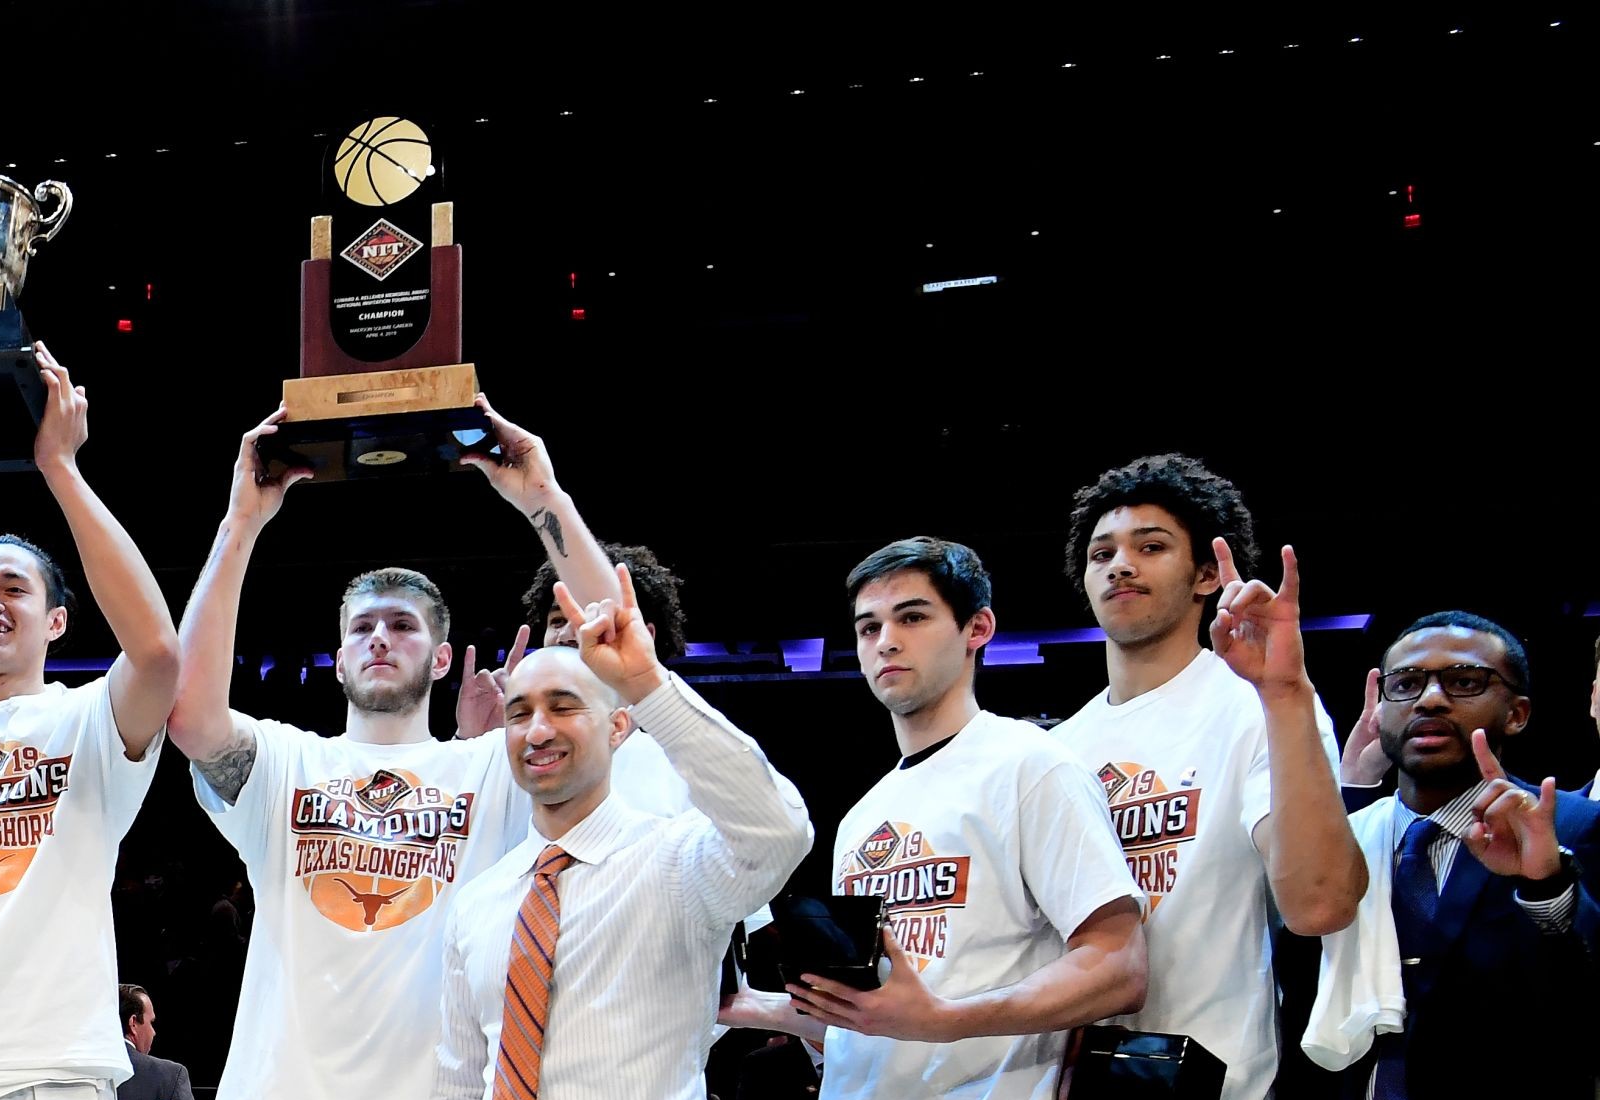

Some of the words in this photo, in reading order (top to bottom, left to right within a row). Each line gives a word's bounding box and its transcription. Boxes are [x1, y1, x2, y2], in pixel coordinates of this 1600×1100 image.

[362, 242, 404, 258] NIT
[358, 309, 404, 320] CHAMPION
[12, 747, 39, 772] 19
[327, 779, 354, 796] 20
[368, 781, 399, 800] NIT
[415, 787, 441, 806] 19
[1129, 770, 1156, 798] 19
[295, 839, 351, 877] TEXAS
[864, 838, 894, 852] NIT
[902, 831, 922, 858] 19
